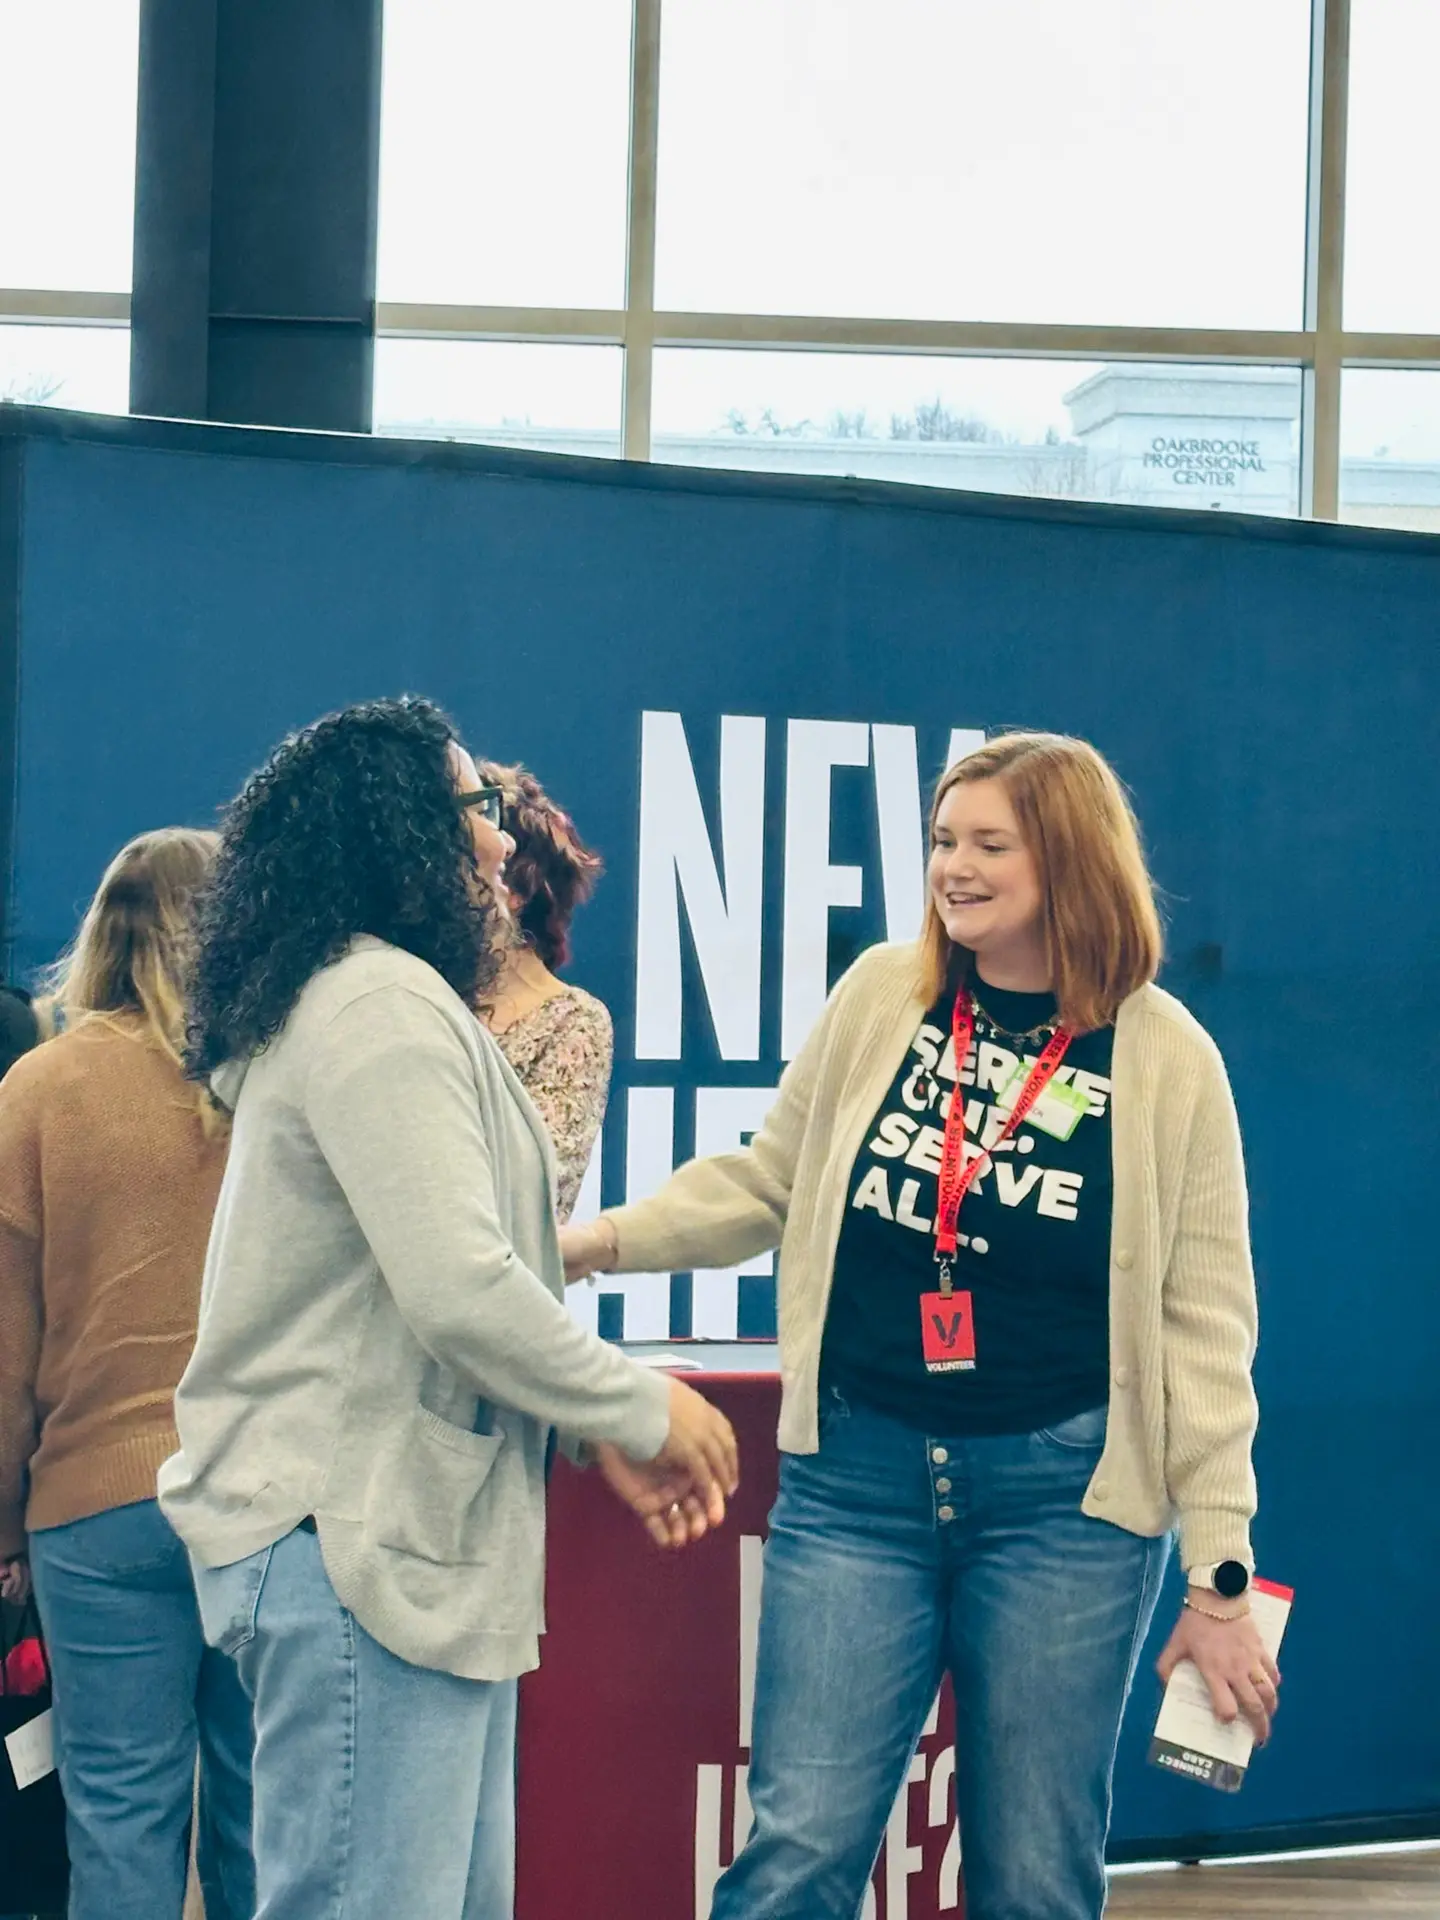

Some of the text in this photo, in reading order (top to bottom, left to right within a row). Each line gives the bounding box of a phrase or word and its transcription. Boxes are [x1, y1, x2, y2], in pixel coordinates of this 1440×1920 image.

[1151, 438, 1259, 456] OAKBROOKE
[1143, 453, 1267, 472] PROFESSIONAL
[1172, 470, 1235, 487] CENTER
[635, 710, 986, 1061] NE
[852, 1165, 989, 1254] AL.
[1157, 1752, 1212, 1779] CONNECT
[1181, 1751, 1214, 1769] CARD
